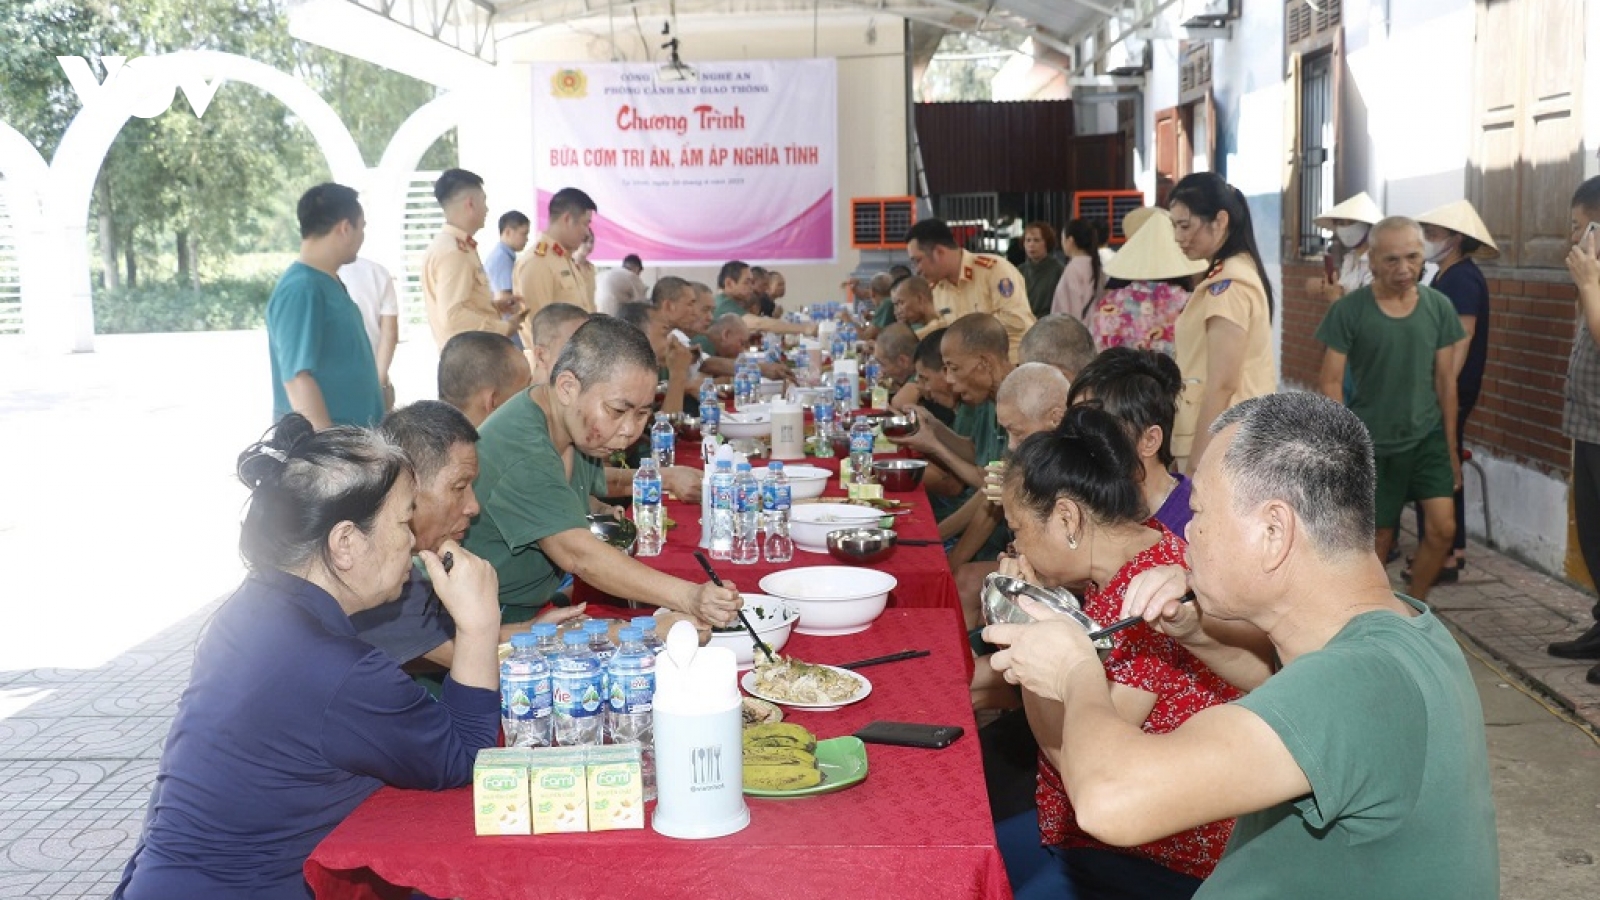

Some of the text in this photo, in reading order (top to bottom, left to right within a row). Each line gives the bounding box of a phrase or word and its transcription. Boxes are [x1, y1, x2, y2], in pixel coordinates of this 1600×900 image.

[735, 72, 751, 81] AN
[700, 84, 728, 94] GIAO
[730, 83, 769, 94] THÔNG
[616, 104, 745, 136] Chương Trình
[583, 147, 617, 167] CƠM
[622, 148, 645, 168] TRI
[709, 143, 729, 167] ÁP
[733, 141, 780, 166] NGHĨA
[784, 140, 819, 166] TÌNH
